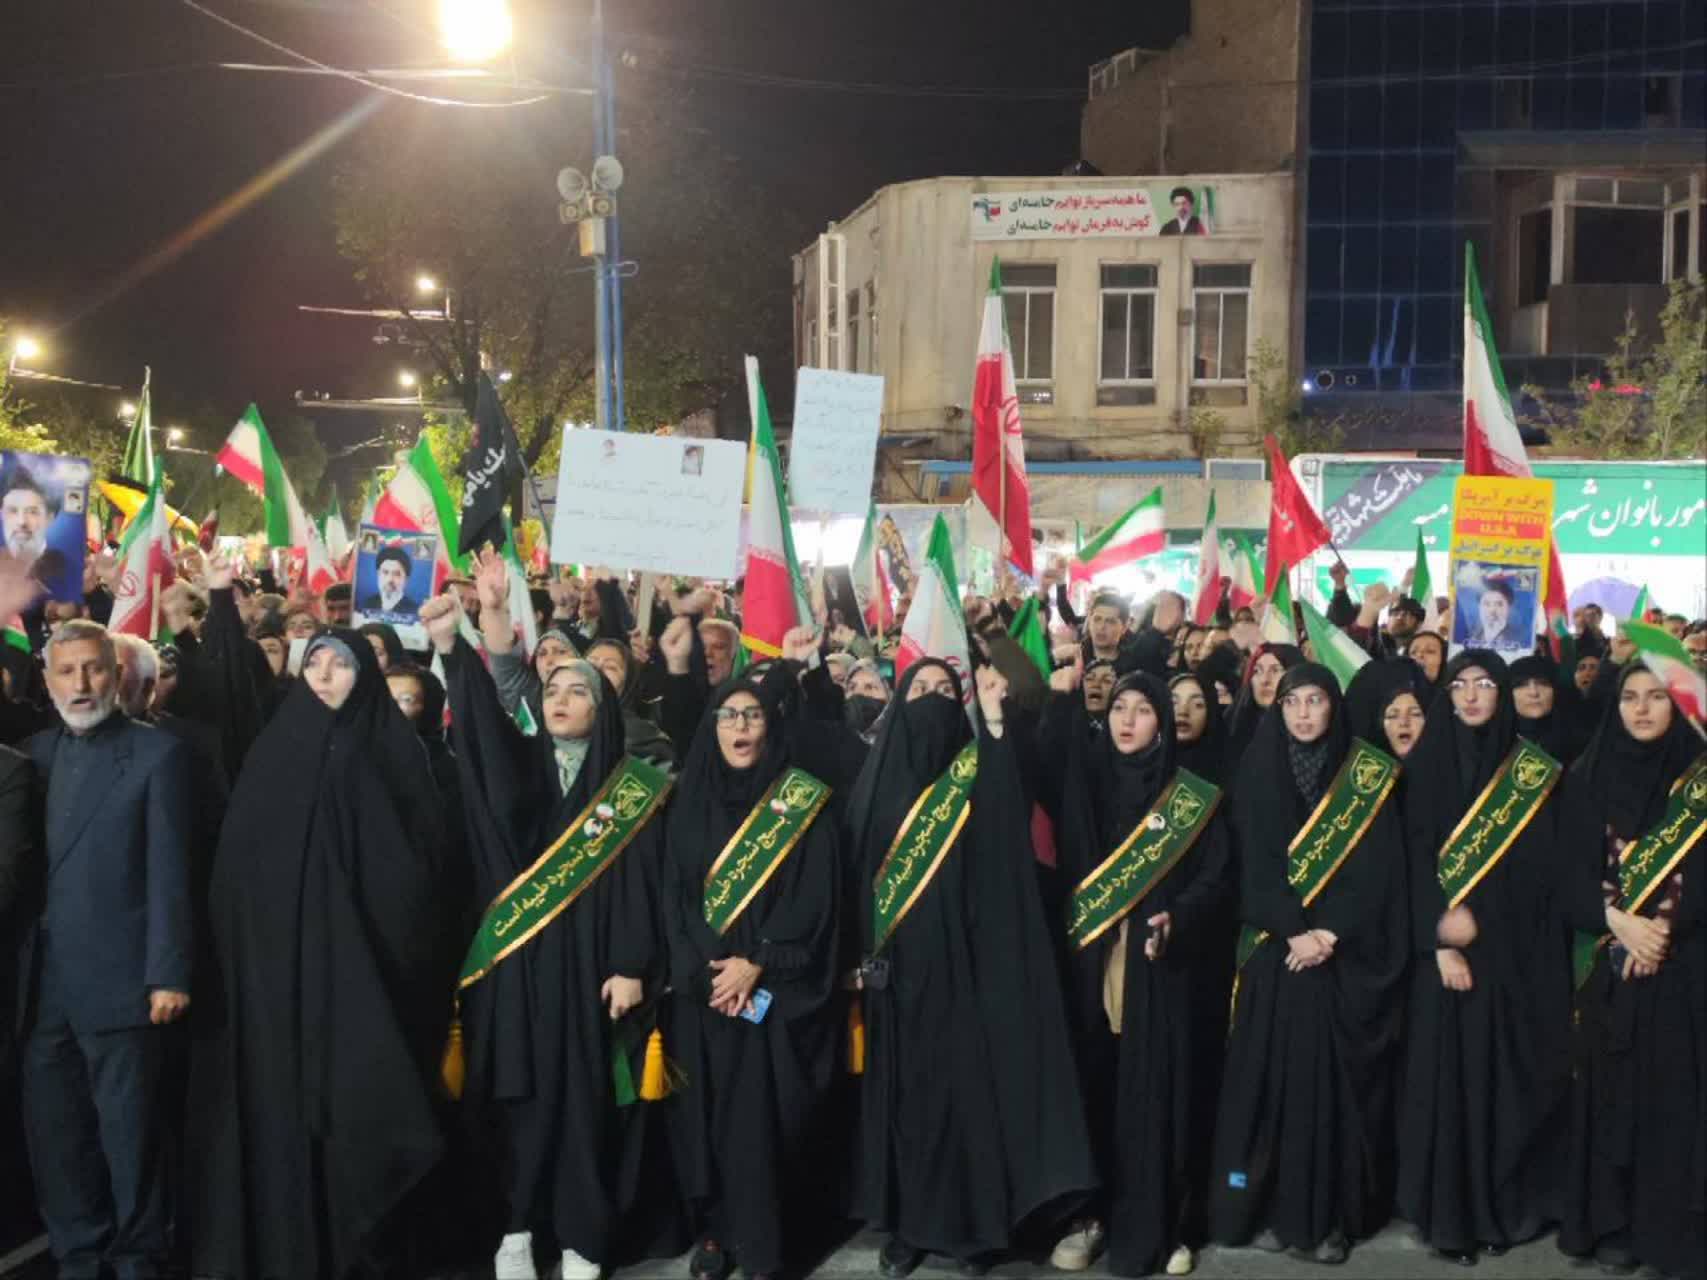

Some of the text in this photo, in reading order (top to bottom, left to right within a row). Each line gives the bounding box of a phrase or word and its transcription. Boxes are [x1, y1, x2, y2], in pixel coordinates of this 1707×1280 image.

[1587, 479, 1662, 547] بانوان
[1664, 497, 1707, 527] مور
[932, 785, 962, 822] بسیج
[1333, 795, 1366, 830] بسیج
[1491, 789, 1524, 824] بسیج
[583, 820, 619, 857] بسیج
[757, 816, 791, 849] بسیج
[1143, 825, 1178, 861] بسیج
[1660, 808, 1696, 844] بسیج
